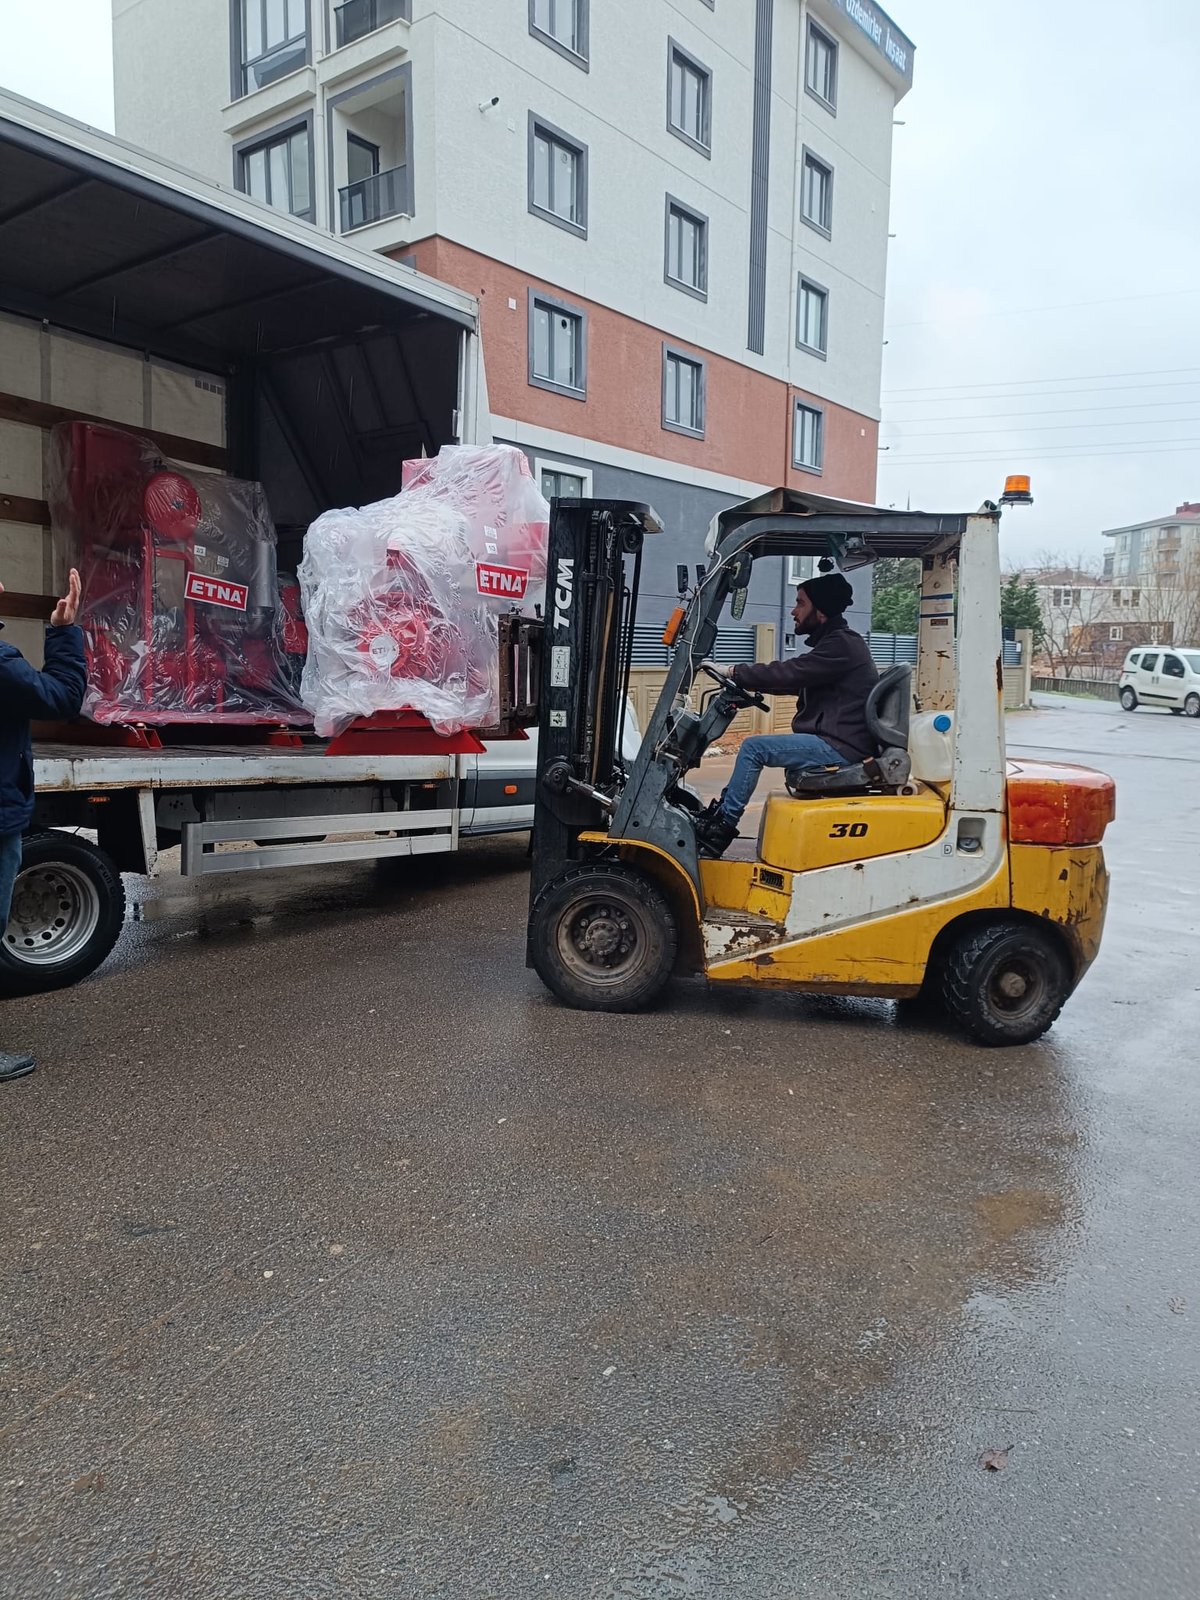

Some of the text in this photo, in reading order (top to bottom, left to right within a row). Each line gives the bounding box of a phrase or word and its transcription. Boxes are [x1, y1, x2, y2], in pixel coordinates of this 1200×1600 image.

[191, 579, 242, 604] ETNA
[480, 569, 522, 593] ETNA
[553, 558, 574, 630] TCM
[828, 823, 868, 838] 30
